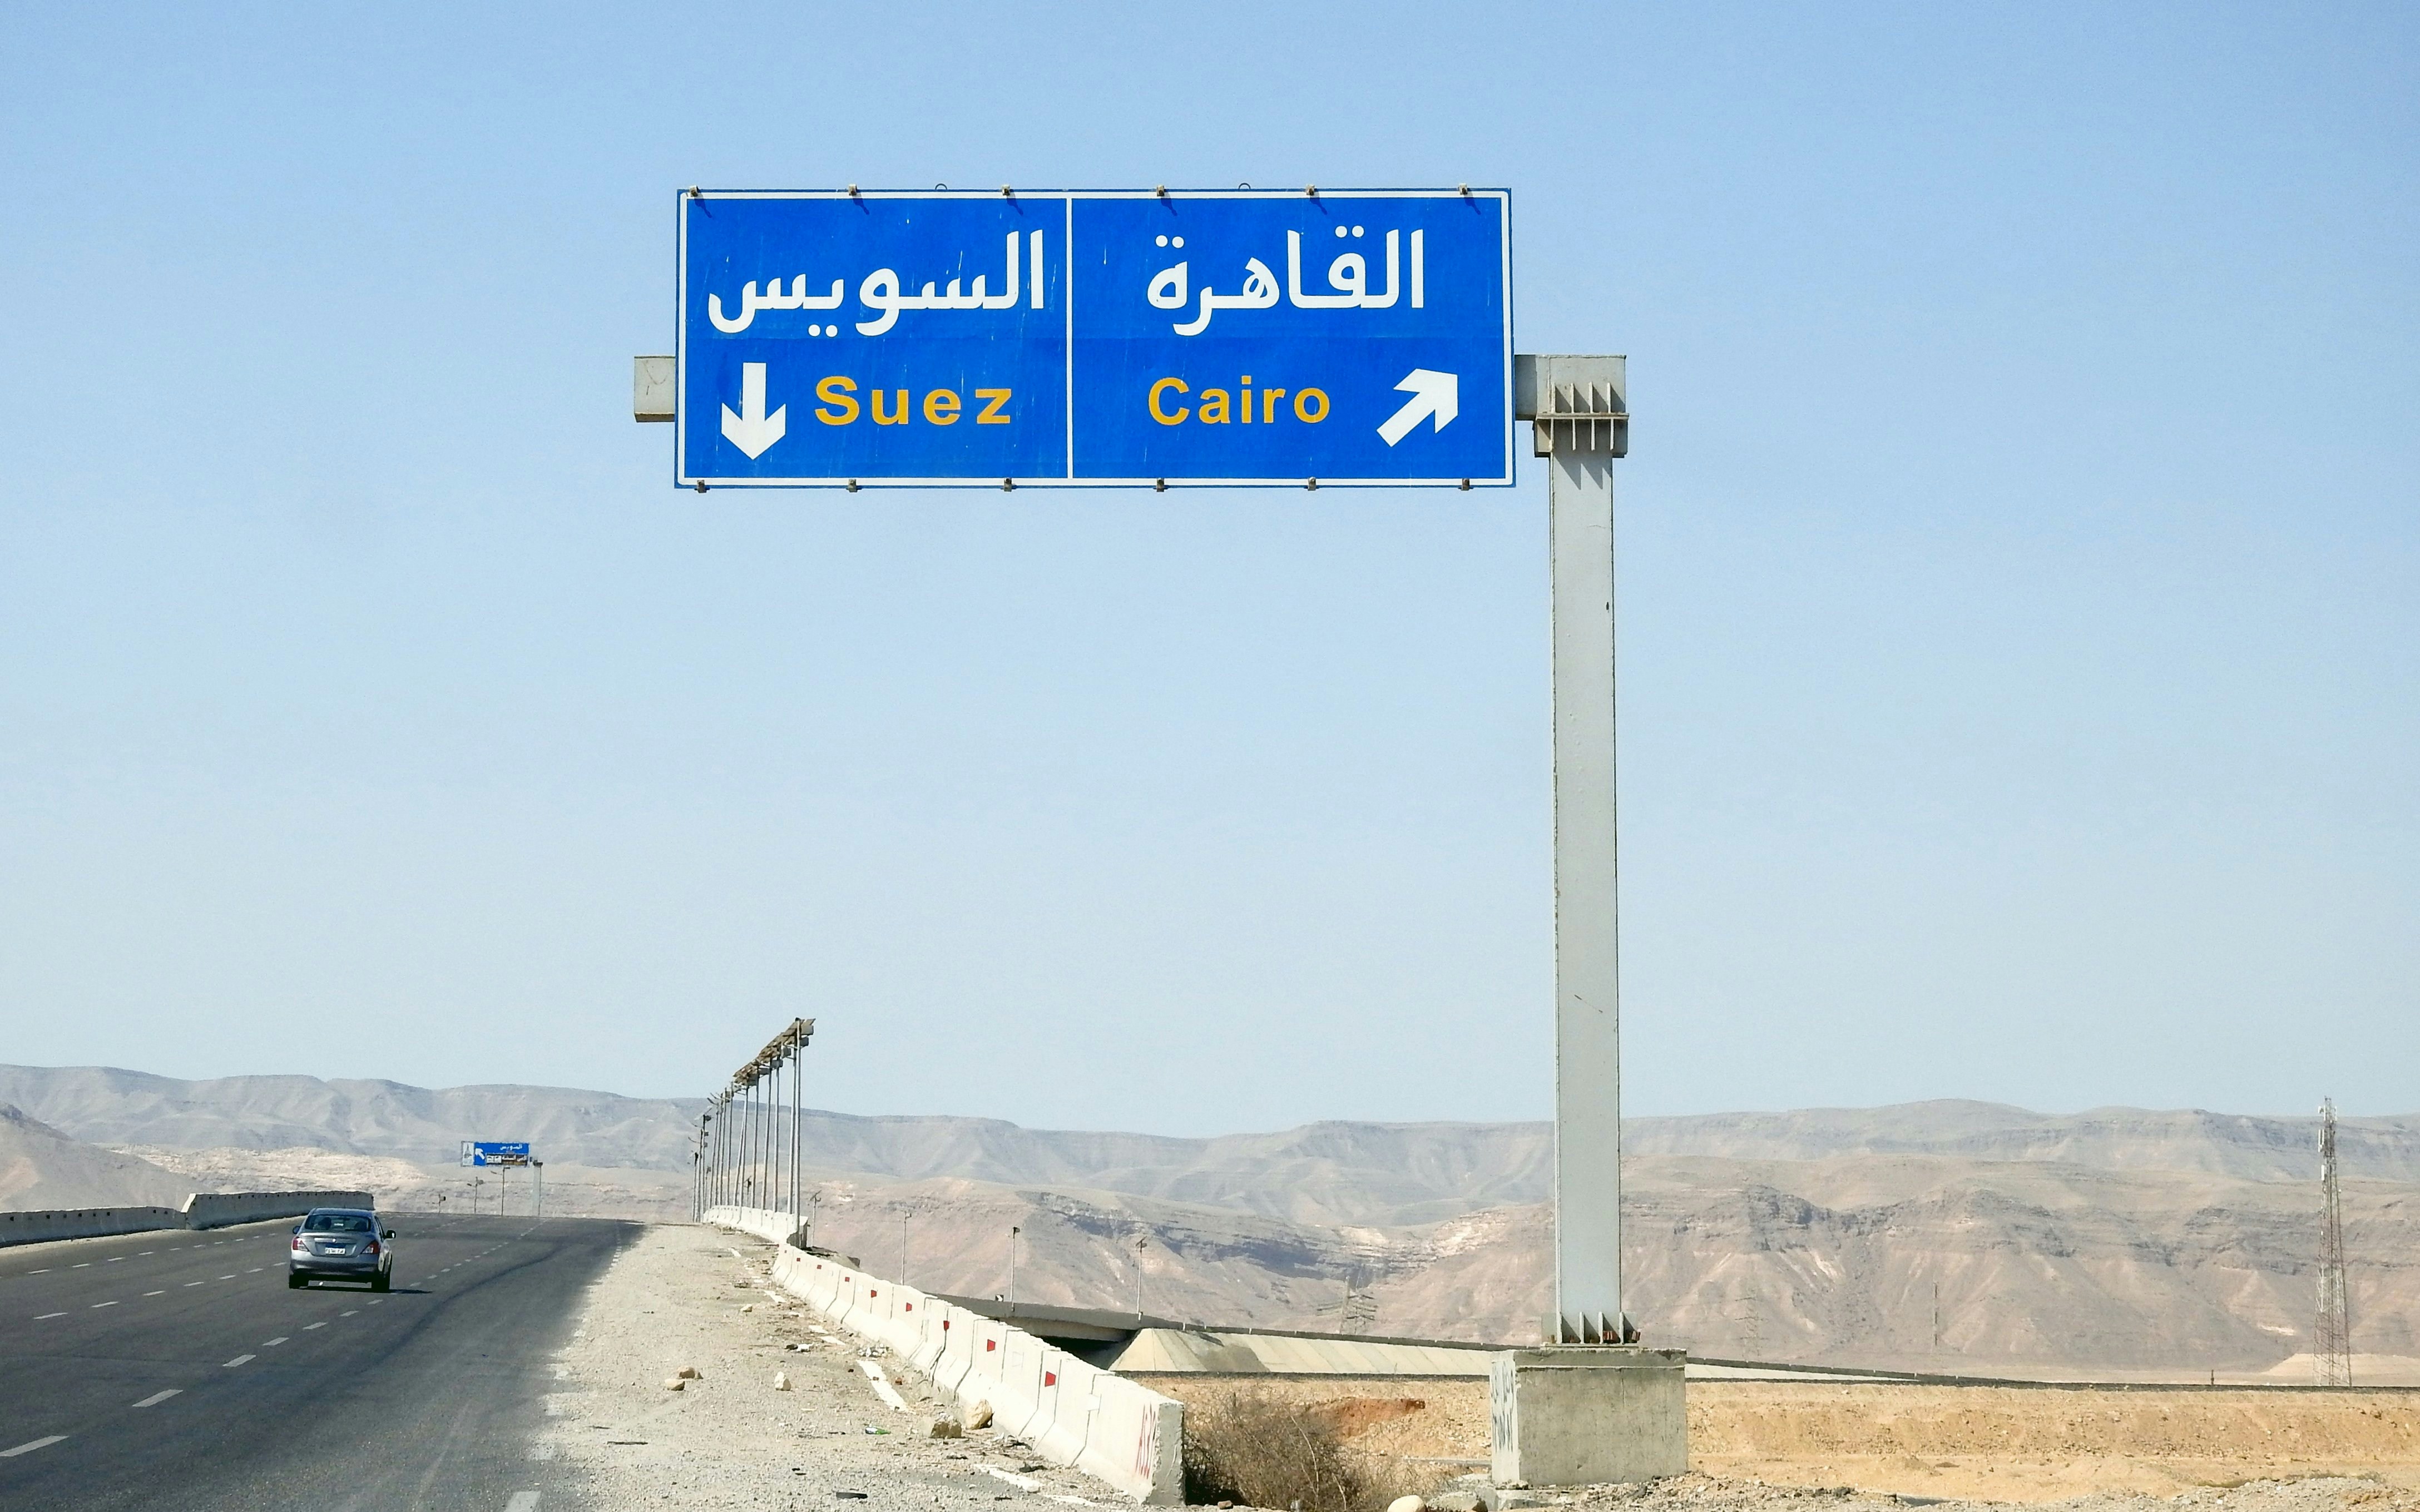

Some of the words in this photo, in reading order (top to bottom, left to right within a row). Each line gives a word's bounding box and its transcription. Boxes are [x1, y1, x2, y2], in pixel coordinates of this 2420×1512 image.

[707, 229, 1044, 338] السويس
[1147, 225, 1424, 336] القاهرة
[815, 375, 1012, 425] Suez
[1148, 375, 1330, 425] Cairo
